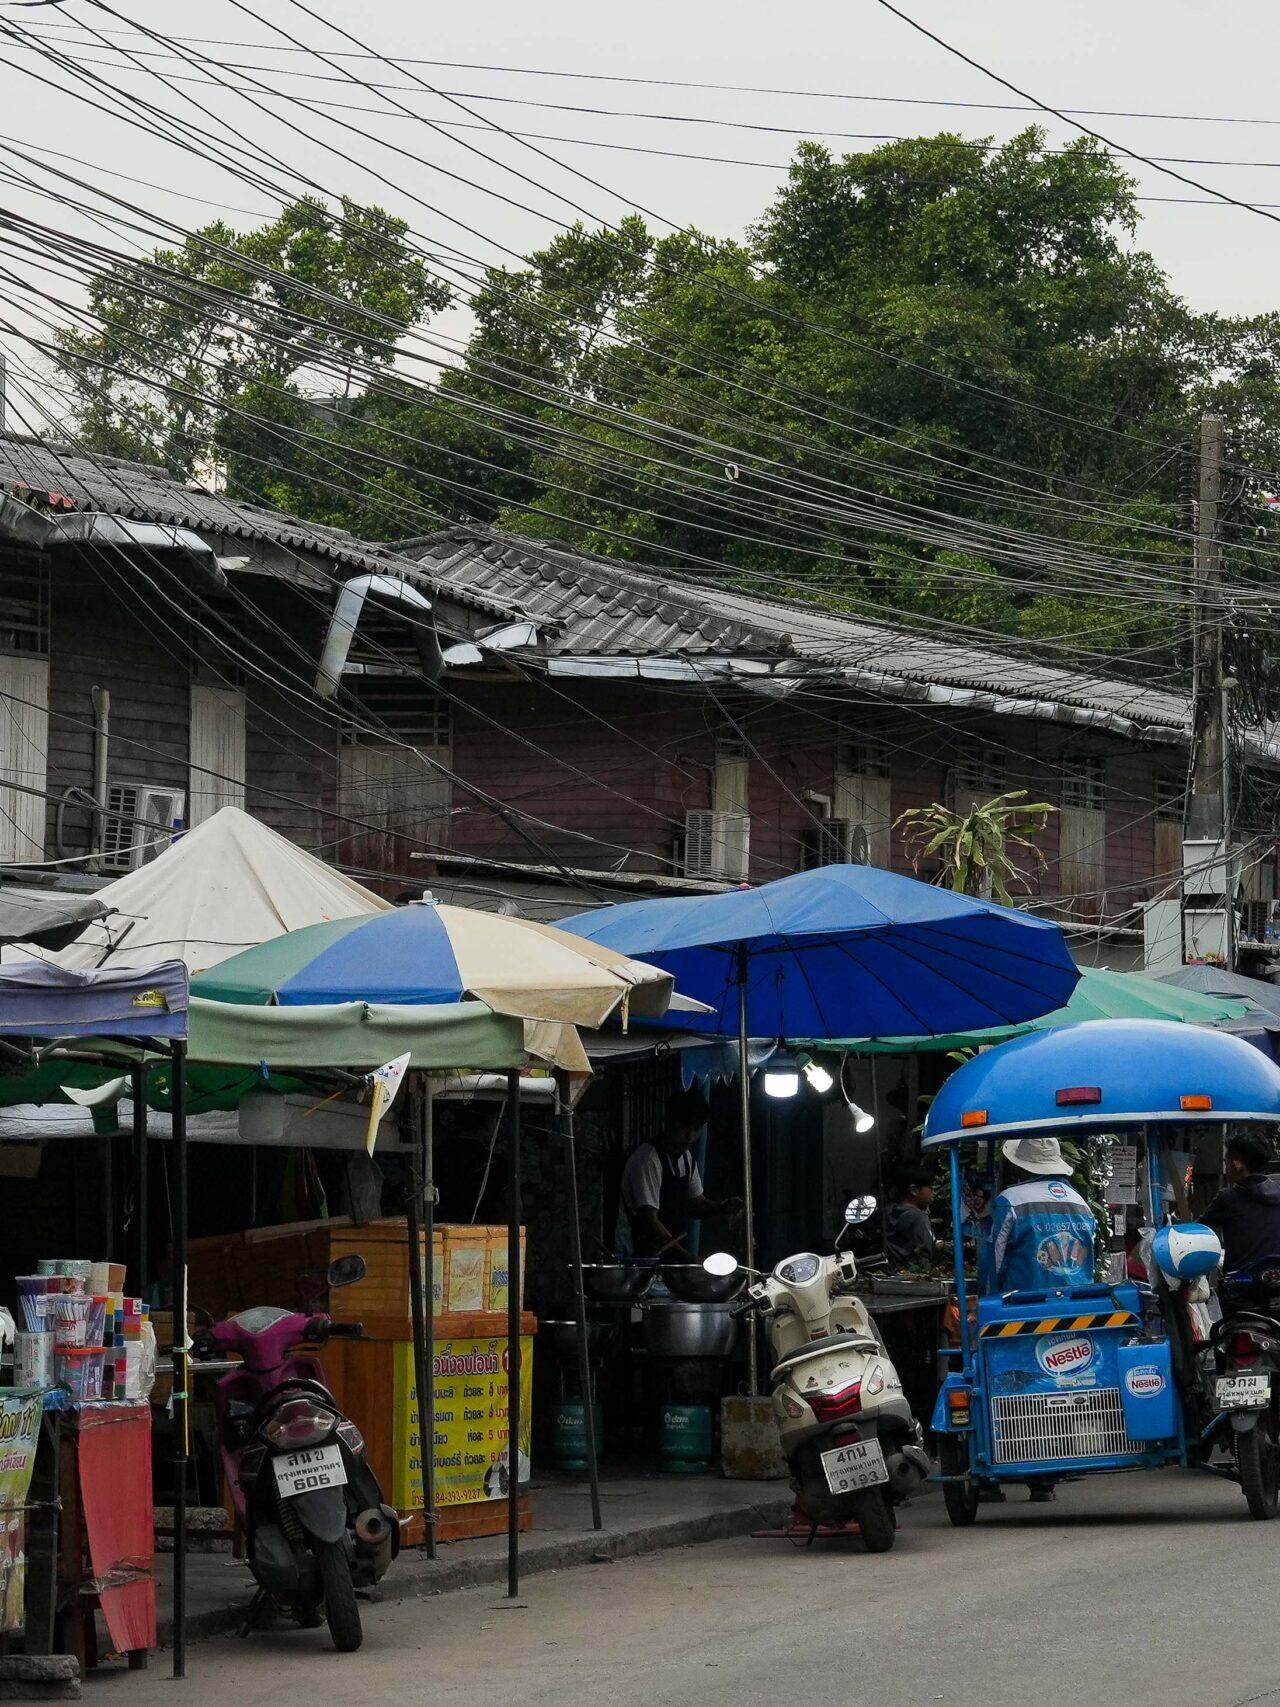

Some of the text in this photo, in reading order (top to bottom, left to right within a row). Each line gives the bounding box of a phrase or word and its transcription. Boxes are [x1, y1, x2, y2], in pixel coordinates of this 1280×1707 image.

[488, 1429, 494, 1440] 5
[491, 1452, 496, 1462] 6
[277, 1462, 341, 1481] กรุงเทพมหานคร
[293, 1474, 331, 1491] 606
[434, 1489, 480, 1504] 84-393-9237
